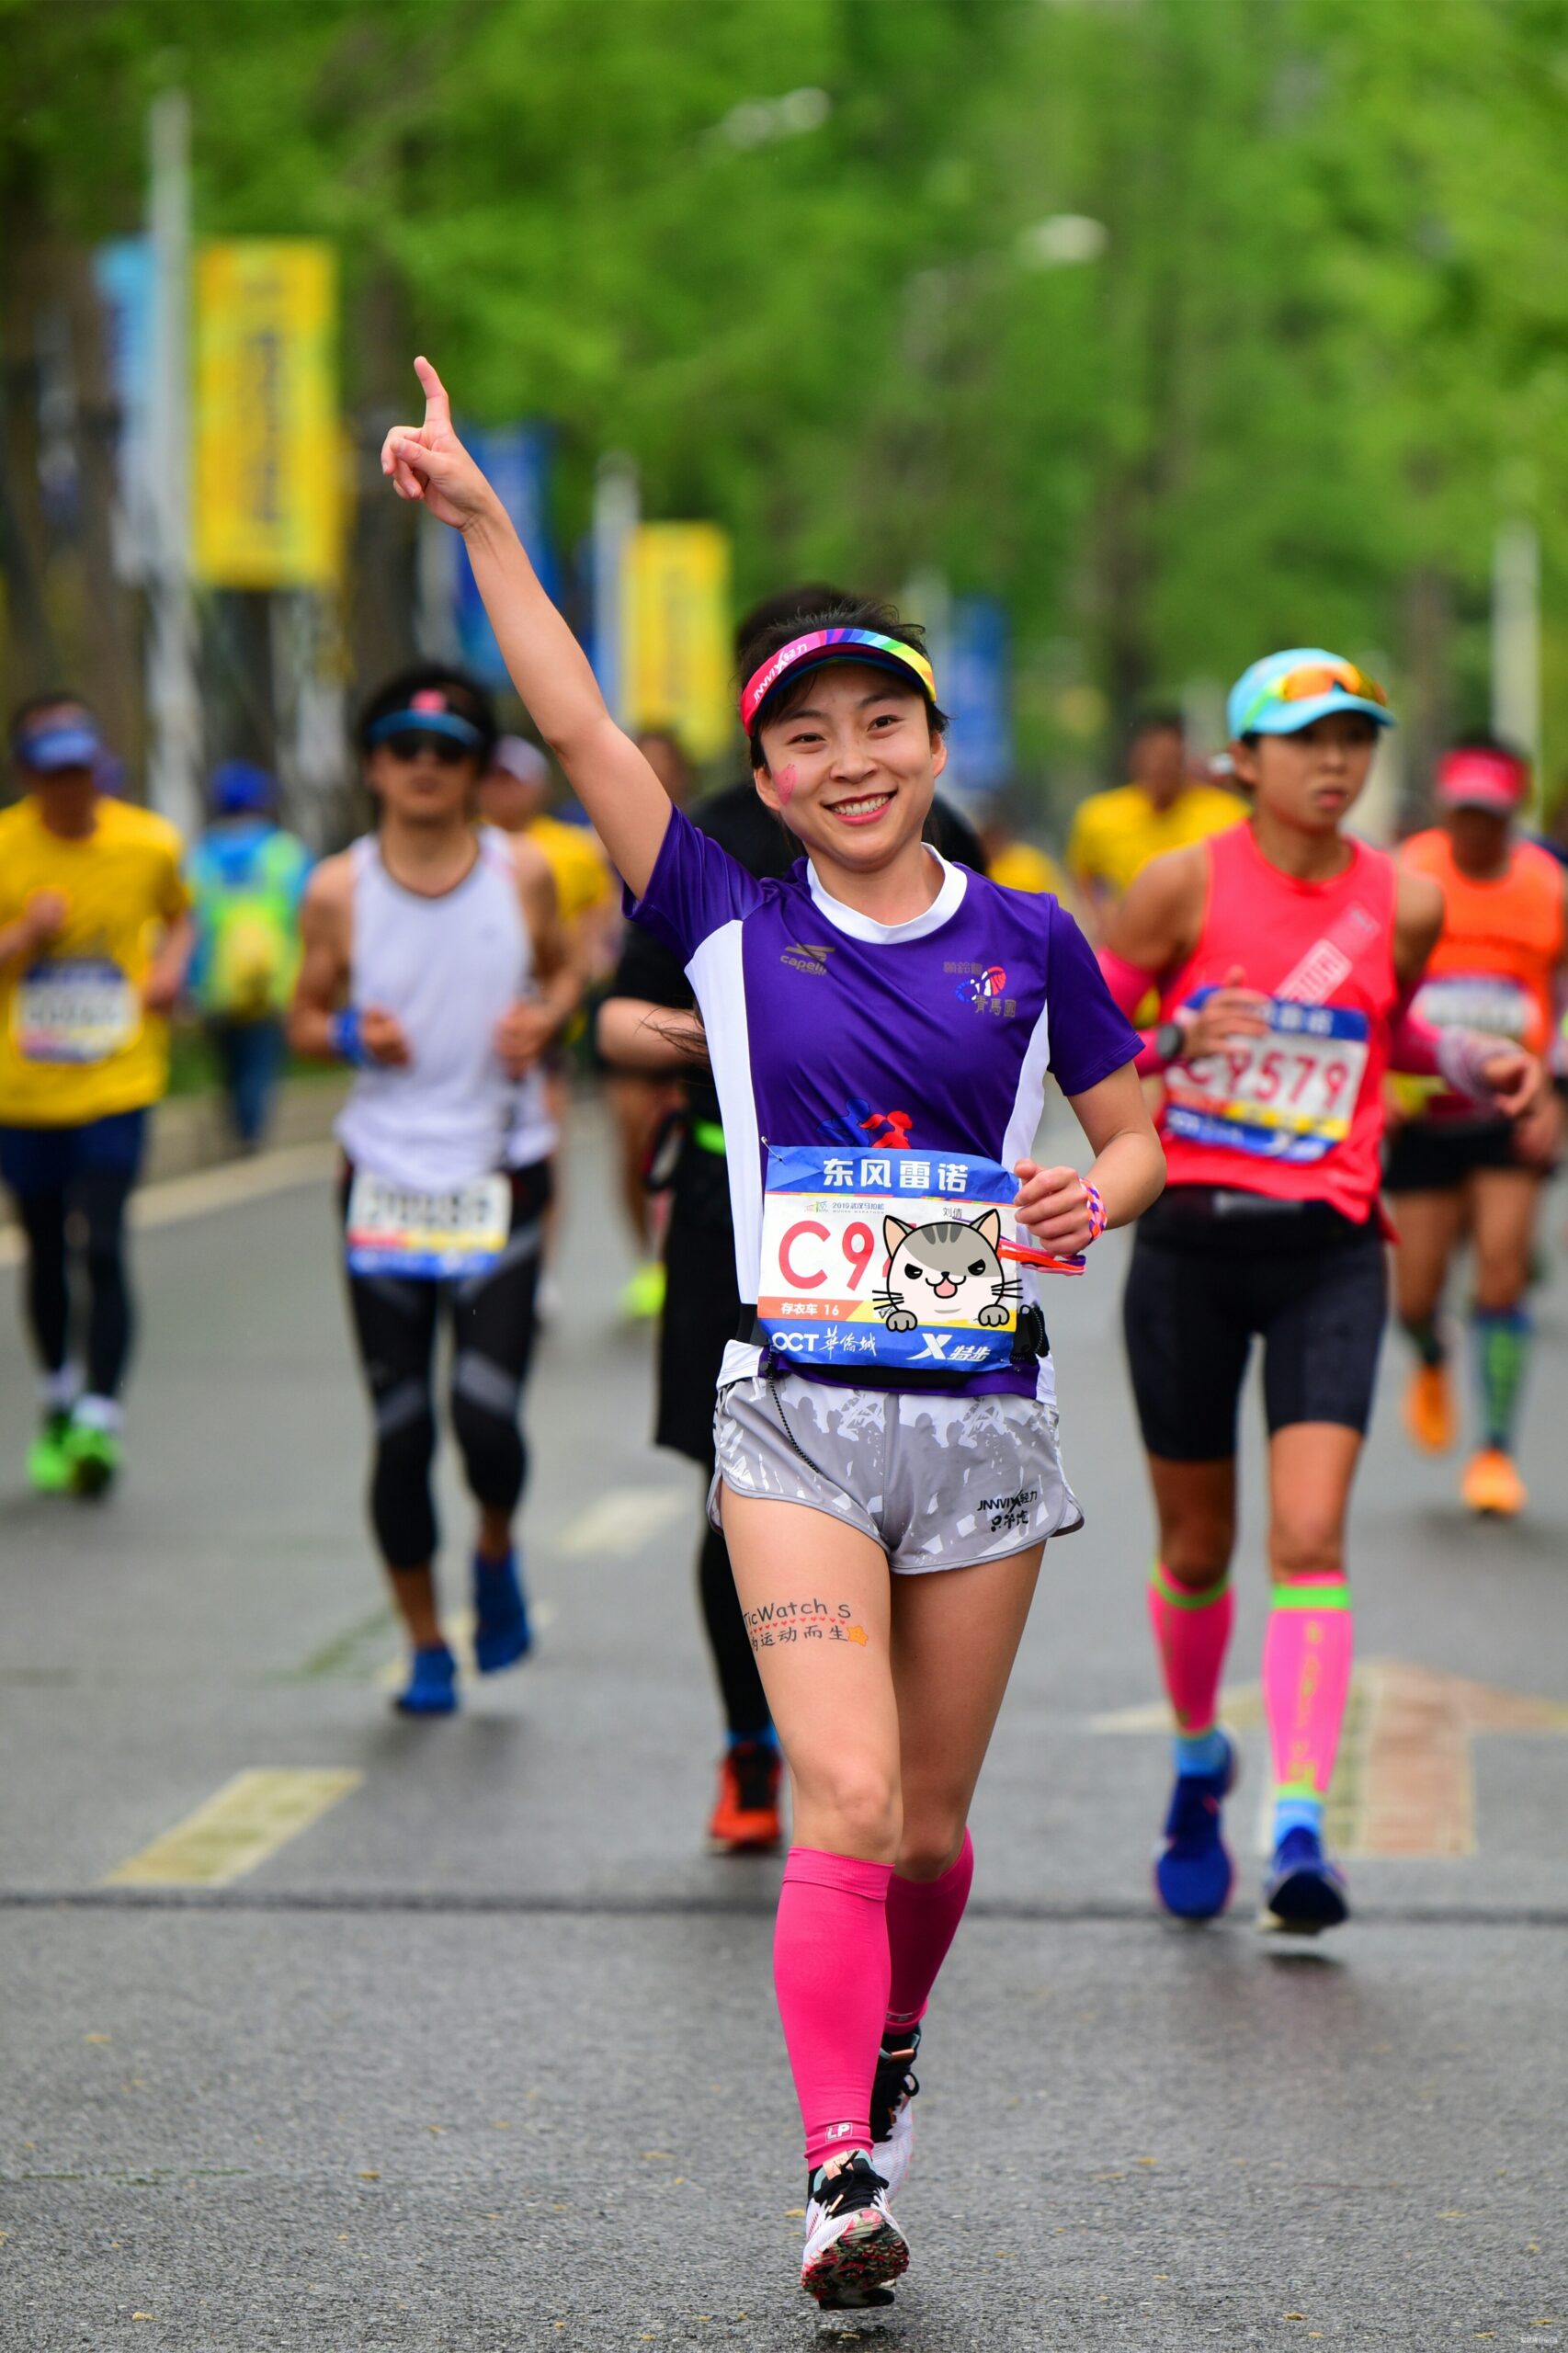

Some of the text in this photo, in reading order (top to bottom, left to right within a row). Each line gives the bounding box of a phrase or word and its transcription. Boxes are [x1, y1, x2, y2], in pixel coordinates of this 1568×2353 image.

[823, 1158, 969, 1192] 东风雷诺
[778, 1220, 917, 1291] C9
[780, 1302, 839, 1315] 存衣车 16
[772, 1332, 820, 1351] OCT
[948, 1345, 992, 1361] 特步
[744, 1598, 828, 1628] TicWatch
[827, 2124, 851, 2140] LP
